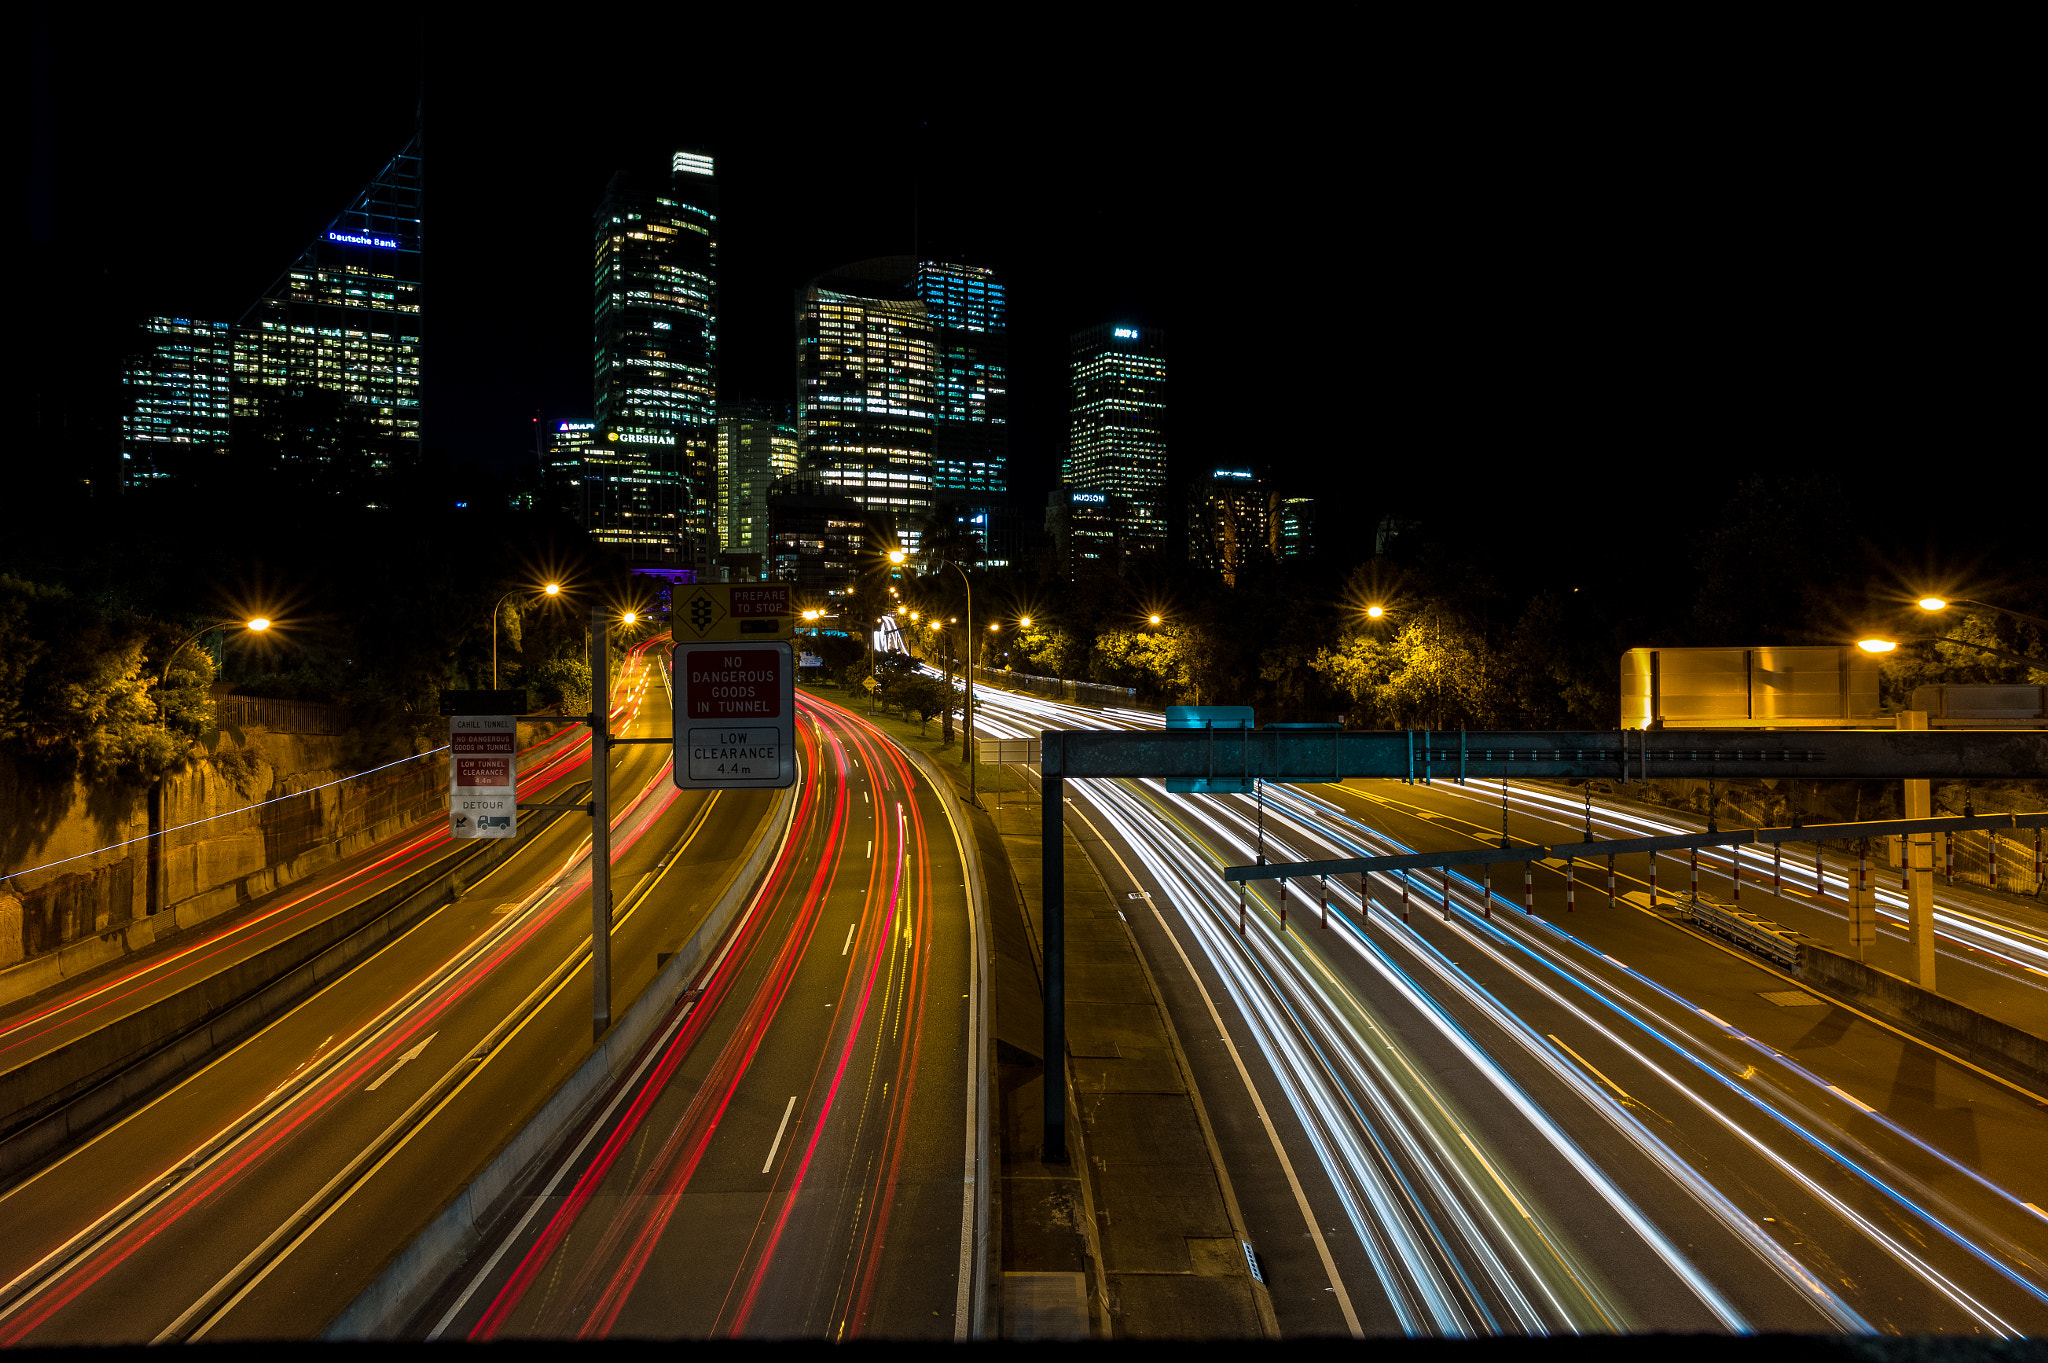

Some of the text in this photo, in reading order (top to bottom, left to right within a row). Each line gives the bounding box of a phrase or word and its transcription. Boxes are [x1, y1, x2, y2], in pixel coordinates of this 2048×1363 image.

[330, 232, 397, 248] Deutsche Bank
[619, 433, 675, 445] GRESHAM
[1073, 493, 1104, 502] HUDSON
[734, 591, 786, 601] PREPARE
[737, 603, 783, 613] TO STOP
[724, 656, 742, 668] NO
[692, 670, 774, 683] DANGEROUS
[711, 686, 756, 698] GOODS
[697, 700, 770, 713] IN TUNNEL
[457, 720, 509, 729] CAHILL TUNNEL
[456, 735, 510, 743] NO DANGEROUS
[720, 733, 747, 744] LOW
[694, 747, 775, 759] CLEARANCE
[461, 760, 505, 768] LOW TUNNEL
[463, 801, 504, 810] DETOUR
